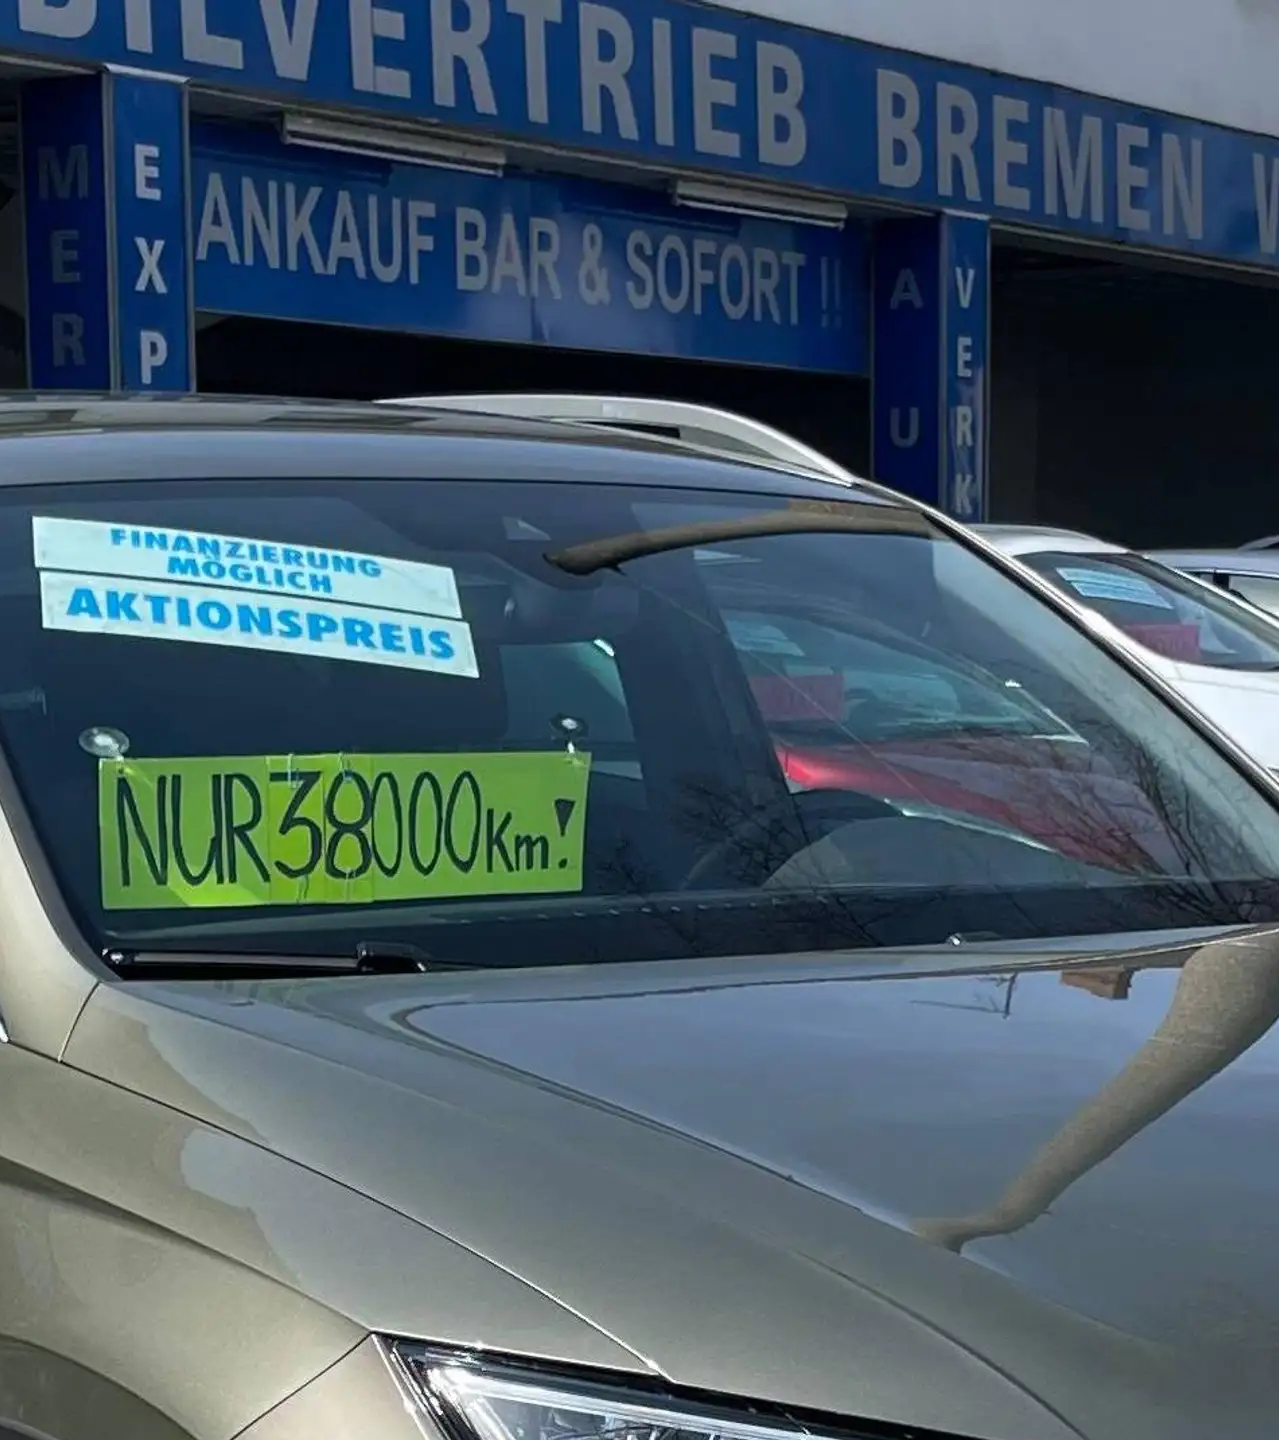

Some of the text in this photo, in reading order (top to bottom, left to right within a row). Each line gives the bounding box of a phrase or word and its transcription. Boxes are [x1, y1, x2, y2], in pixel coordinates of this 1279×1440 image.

[875, 67, 1205, 242] BREMEN
[196, 171, 435, 285] ANKAUF
[456, 206, 562, 300] BAR
[578, 221, 610, 305] &
[624, 229, 806, 327] SOFORT
[109, 528, 383, 578] FINANZIERUNG
[166, 553, 333, 594] MÖGLICH
[66, 588, 456, 661] AKTIONSPREIS
